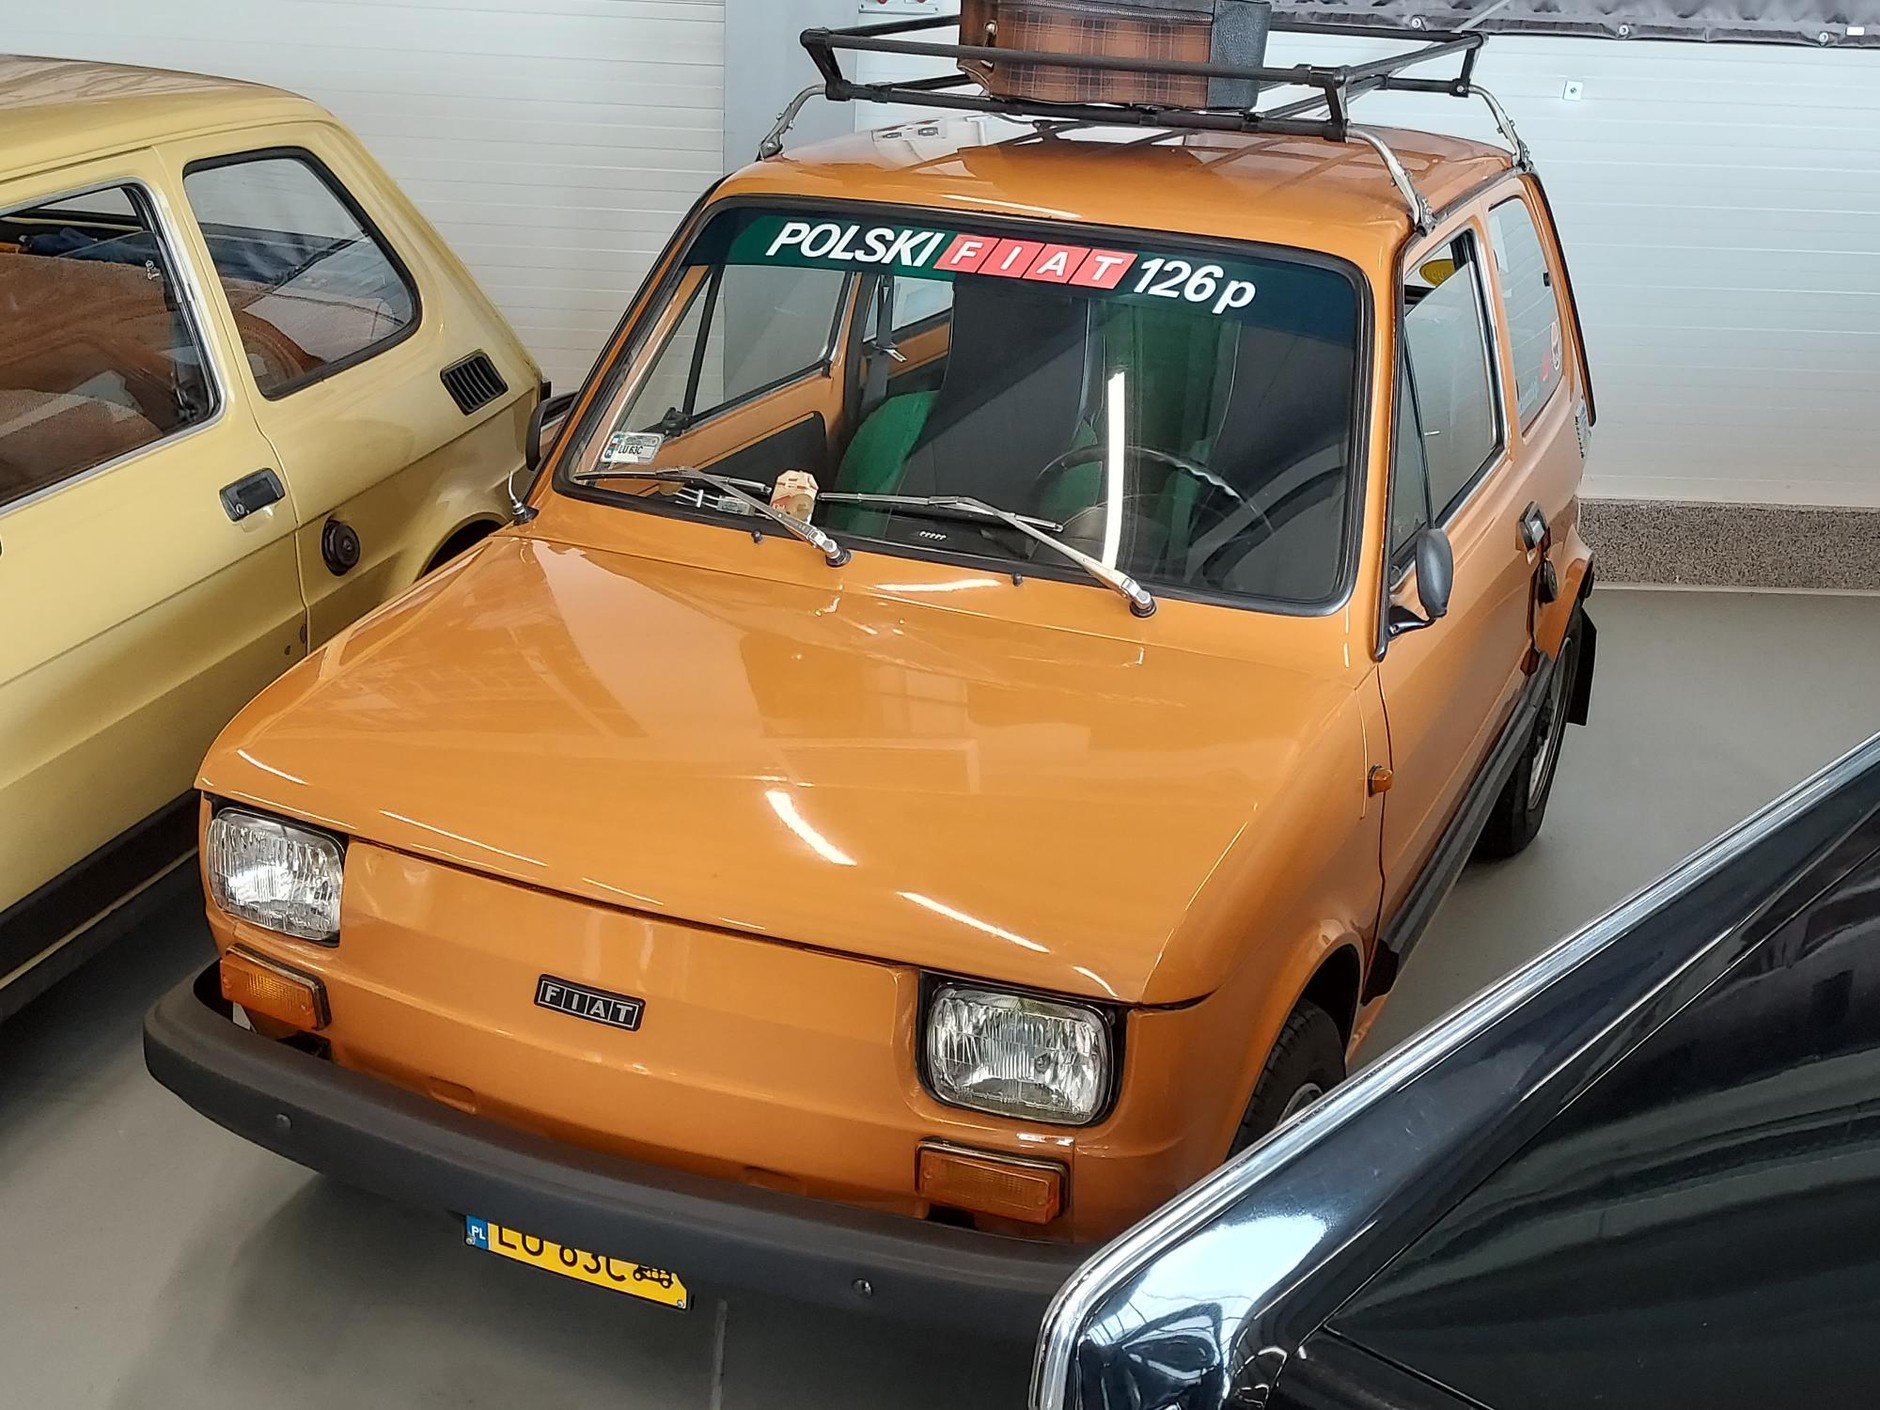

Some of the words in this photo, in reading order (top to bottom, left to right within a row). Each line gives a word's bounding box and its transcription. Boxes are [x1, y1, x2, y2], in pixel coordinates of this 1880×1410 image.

[765, 222, 946, 268] POLSKI
[948, 237, 1126, 283] FIAT
[1132, 257, 1257, 316] 126p
[544, 984, 634, 1022] FIAT
[471, 1225, 486, 1240] PL
